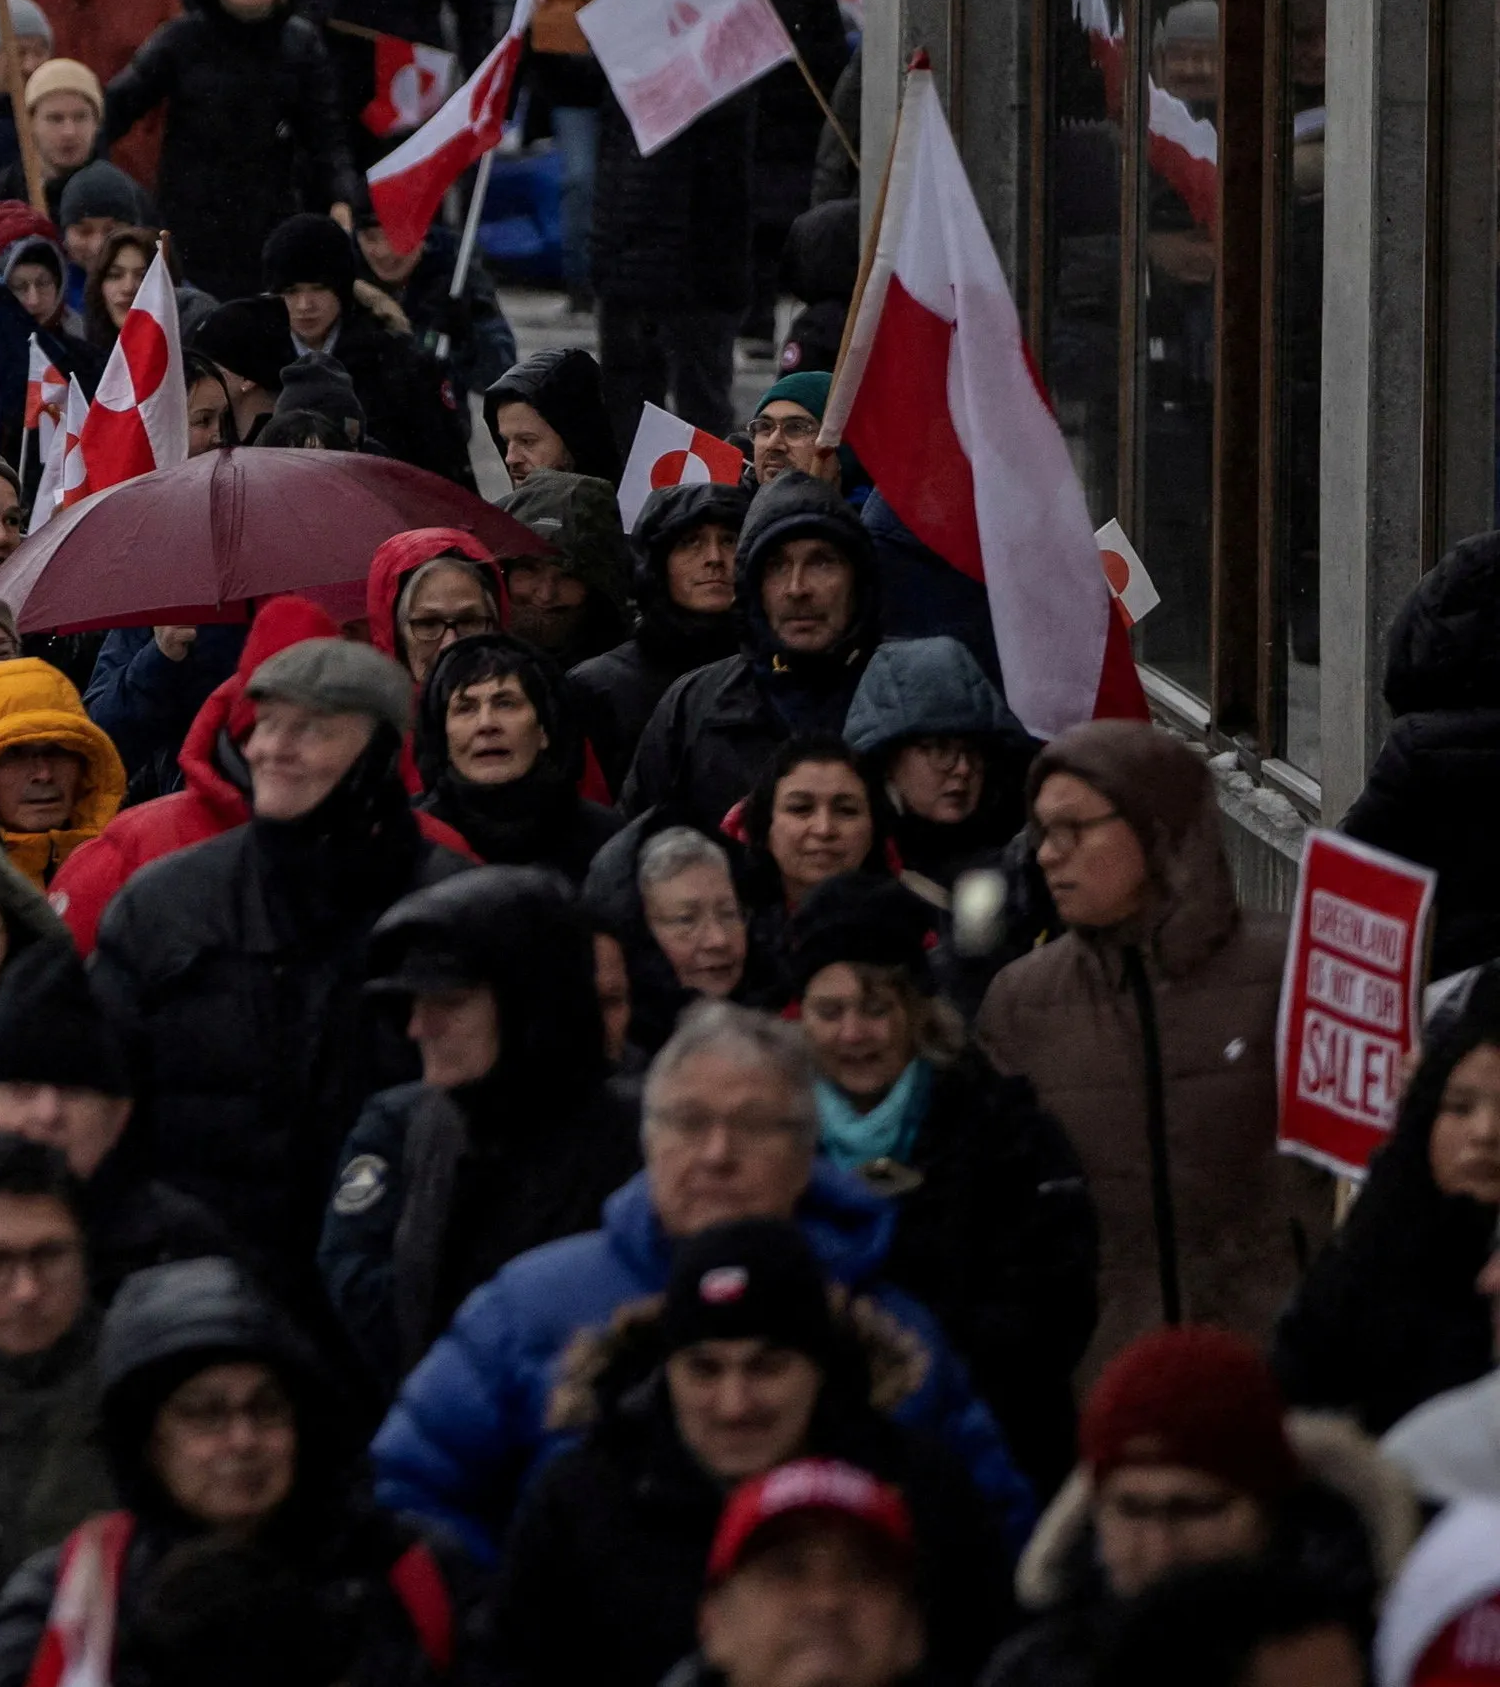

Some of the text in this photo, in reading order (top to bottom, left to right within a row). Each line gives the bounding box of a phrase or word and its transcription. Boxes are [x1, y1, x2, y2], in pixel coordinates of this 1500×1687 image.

[1314, 896, 1399, 963] GREENLAND
[1310, 958, 1396, 1023] IS NOT FOR
[1301, 1017, 1398, 1121] SALE!
